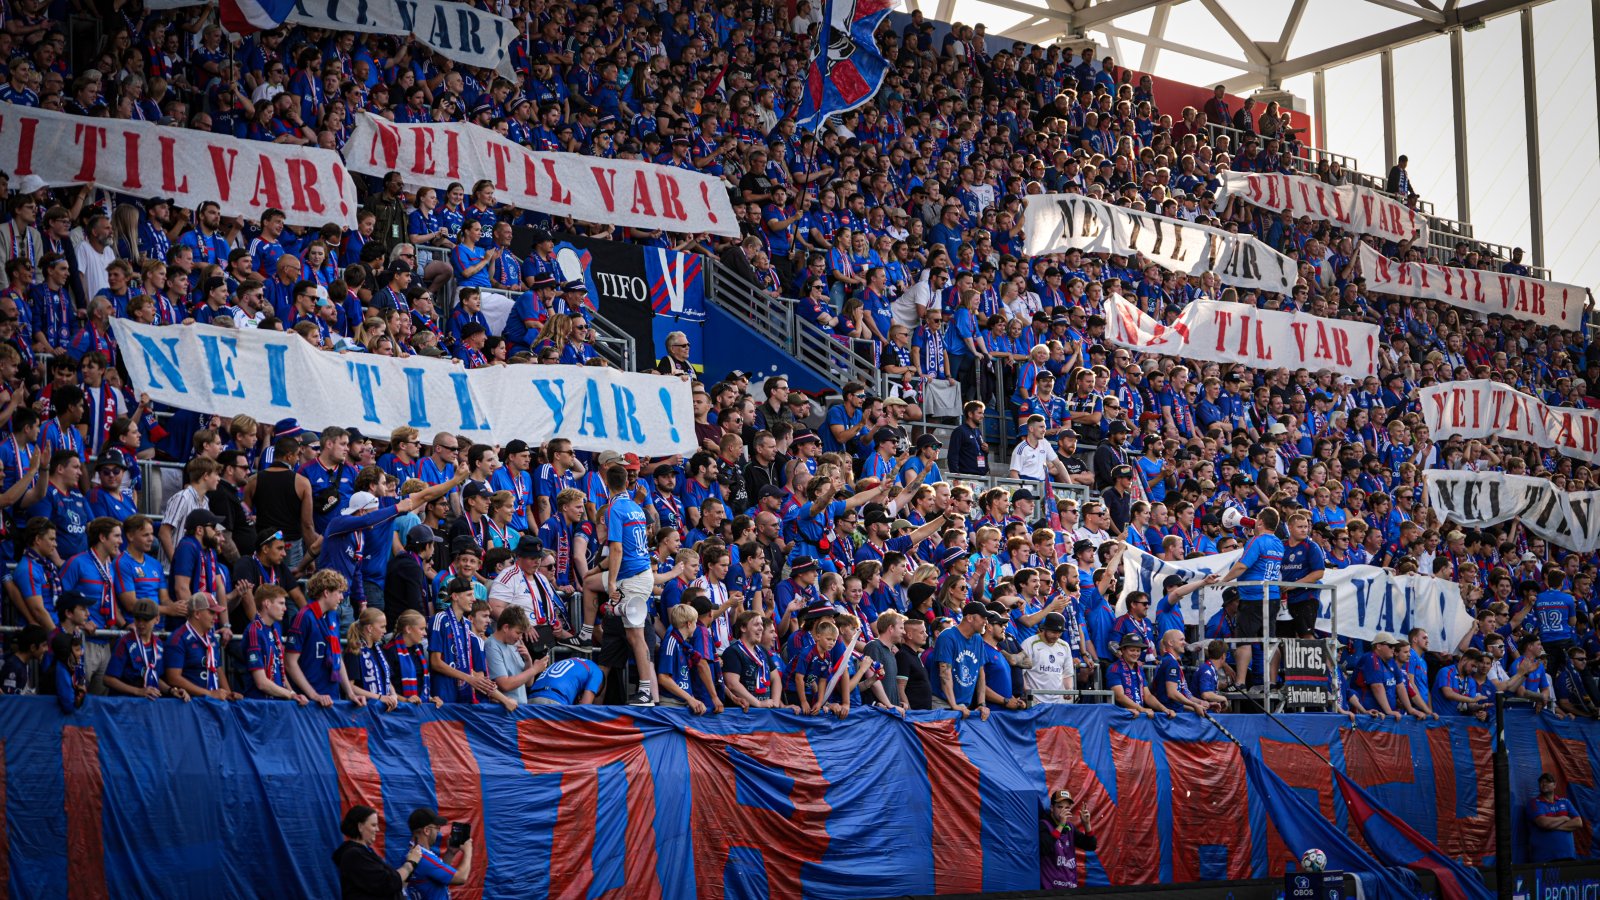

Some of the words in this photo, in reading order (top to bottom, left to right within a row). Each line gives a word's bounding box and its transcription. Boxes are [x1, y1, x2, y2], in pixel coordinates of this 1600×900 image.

[74, 122, 189, 194] TIL
[207, 144, 349, 217] VAR!
[369, 118, 460, 180] NEI
[486, 141, 572, 206] TIL
[1246, 174, 1295, 210] NEI
[1298, 182, 1351, 224] TIL
[1127, 212, 1188, 262] TIL
[597, 271, 648, 303] TIFO
[1374, 255, 1431, 288] NEI
[1438, 265, 1486, 304] TIL
[1214, 310, 1272, 360] TIL
[132, 332, 292, 408] NEI
[346, 360, 491, 430] TIL
[1492, 390, 1534, 436] TIL
[1435, 479, 1501, 522] NEI
[1539, 609, 1564, 632] 12
[1284, 638, 1327, 675] Ultras,
[1293, 888, 1314, 896] OBOS
